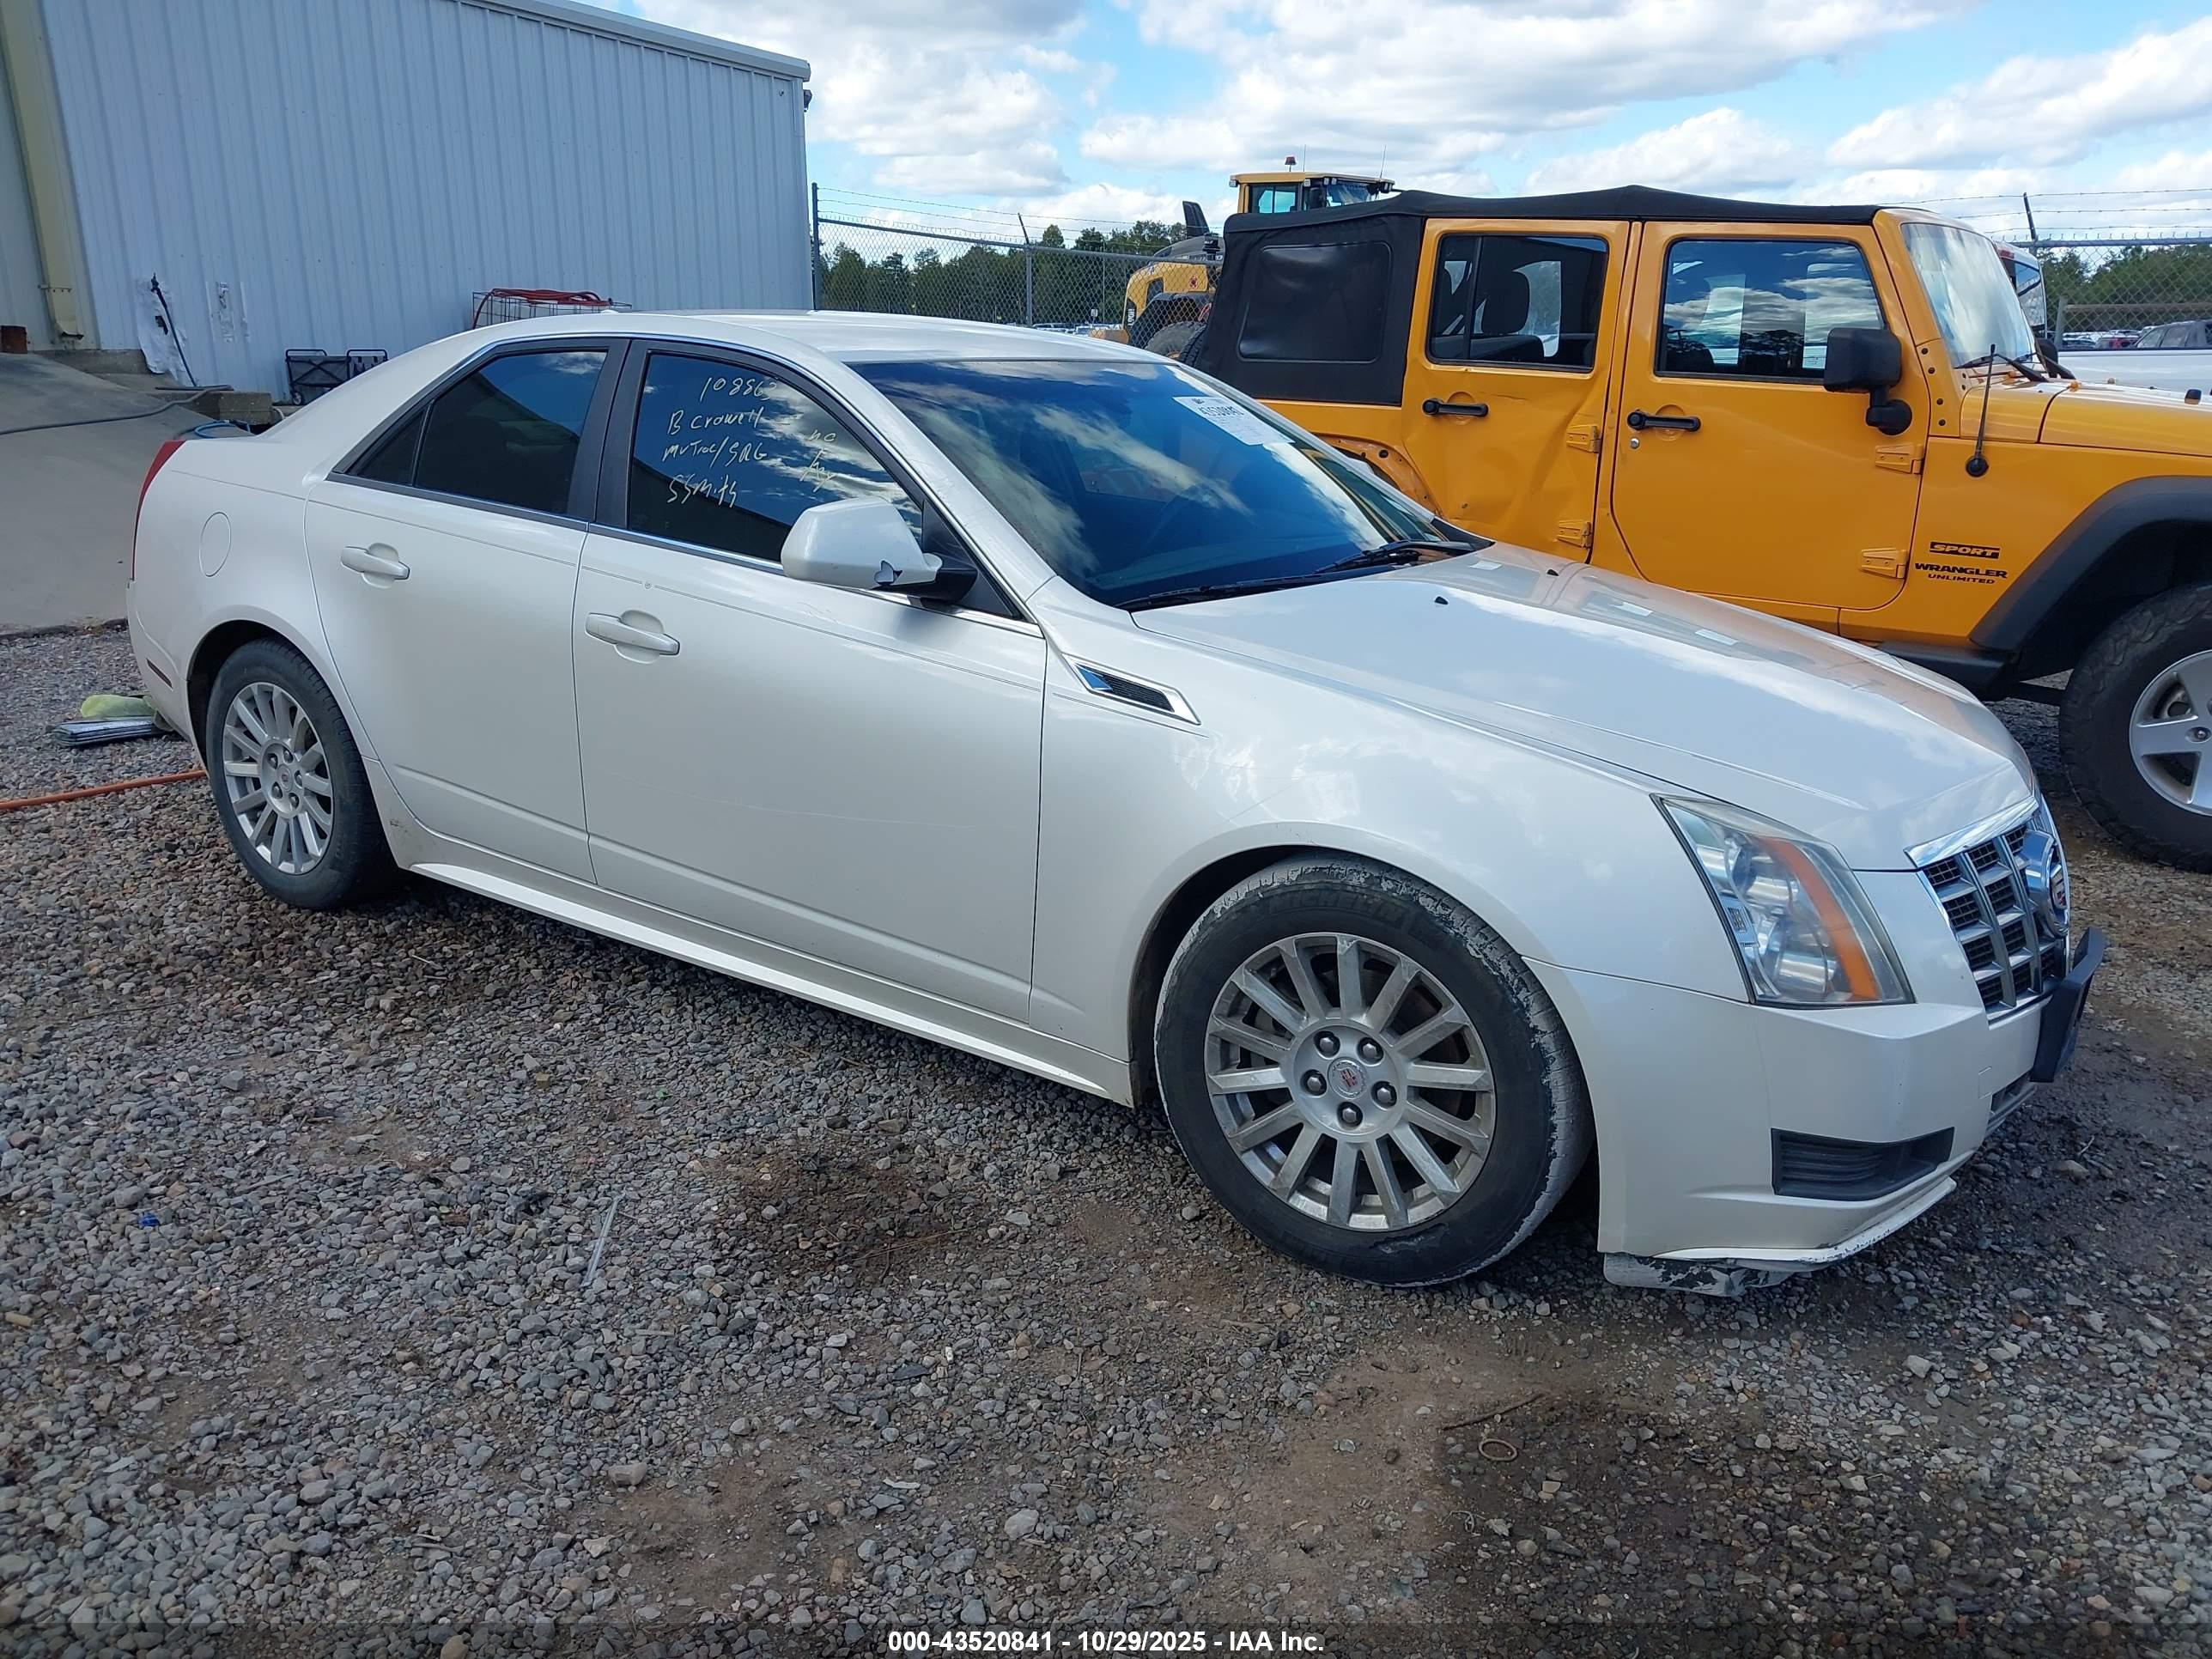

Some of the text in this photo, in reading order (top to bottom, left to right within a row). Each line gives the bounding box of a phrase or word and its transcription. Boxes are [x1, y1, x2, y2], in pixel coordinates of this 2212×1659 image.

[667, 410, 684, 435] B
[1932, 543, 1997, 556] SPORT
[1914, 562, 2008, 579] WRANGLER
[1928, 573, 1996, 585] UNLIMITED
